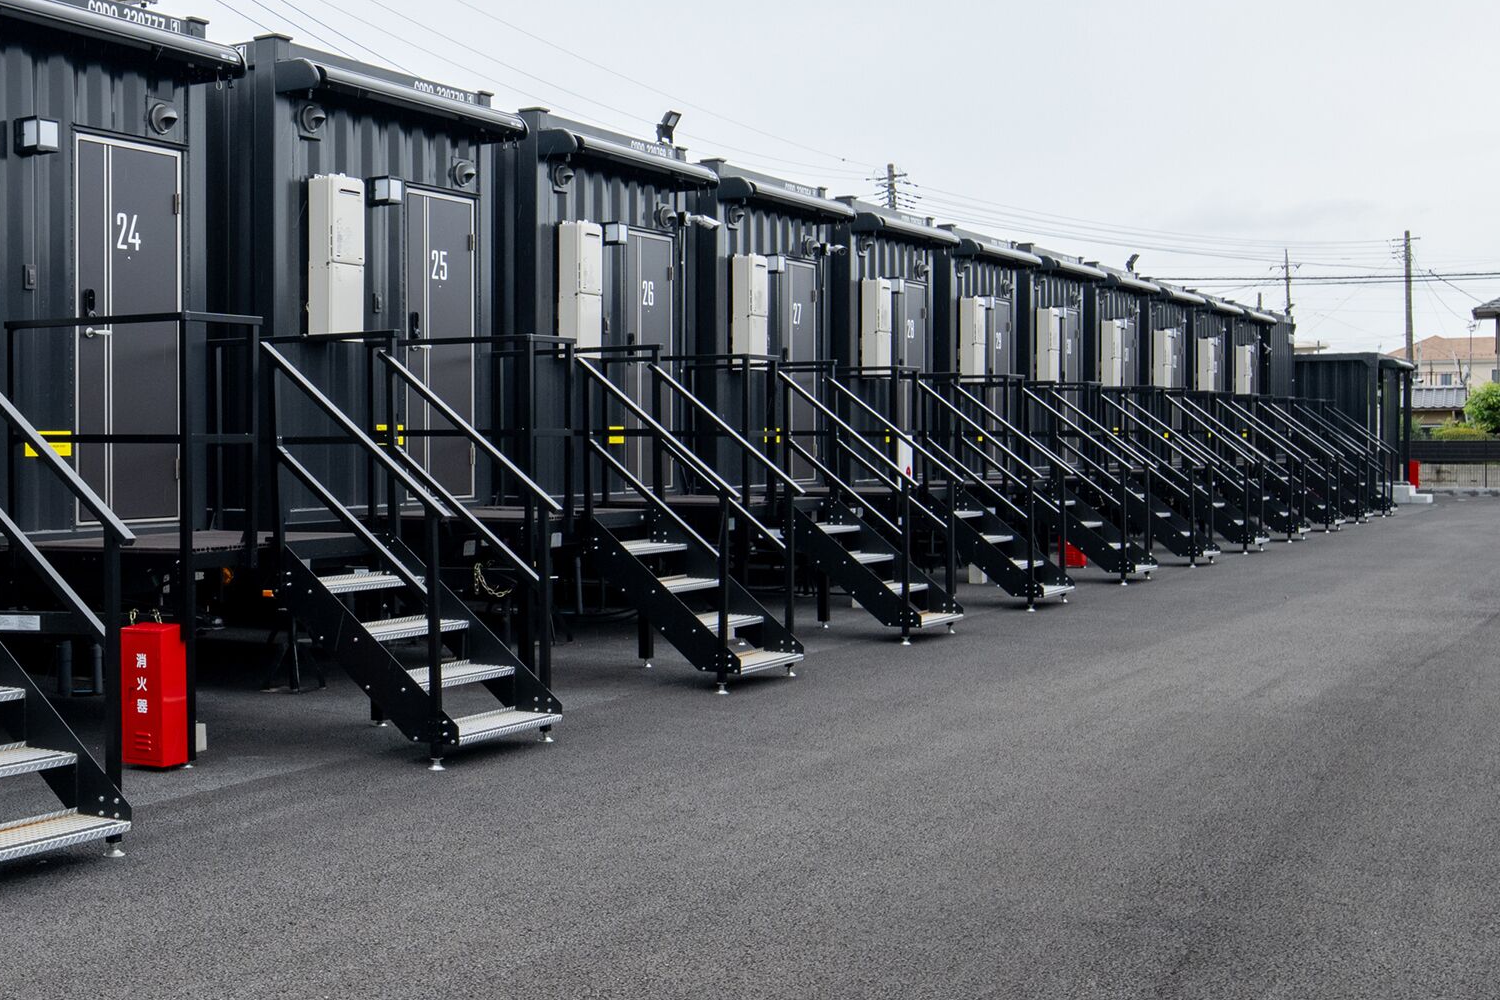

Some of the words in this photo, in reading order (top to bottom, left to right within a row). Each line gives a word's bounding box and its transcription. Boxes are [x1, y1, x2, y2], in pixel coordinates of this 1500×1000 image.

[117, 212, 142, 251] 24
[431, 249, 448, 280] 25
[642, 280, 654, 306] 26
[793, 302, 802, 325] 27
[907, 319, 915, 339] 28
[136, 652, 149, 714] 消火器
